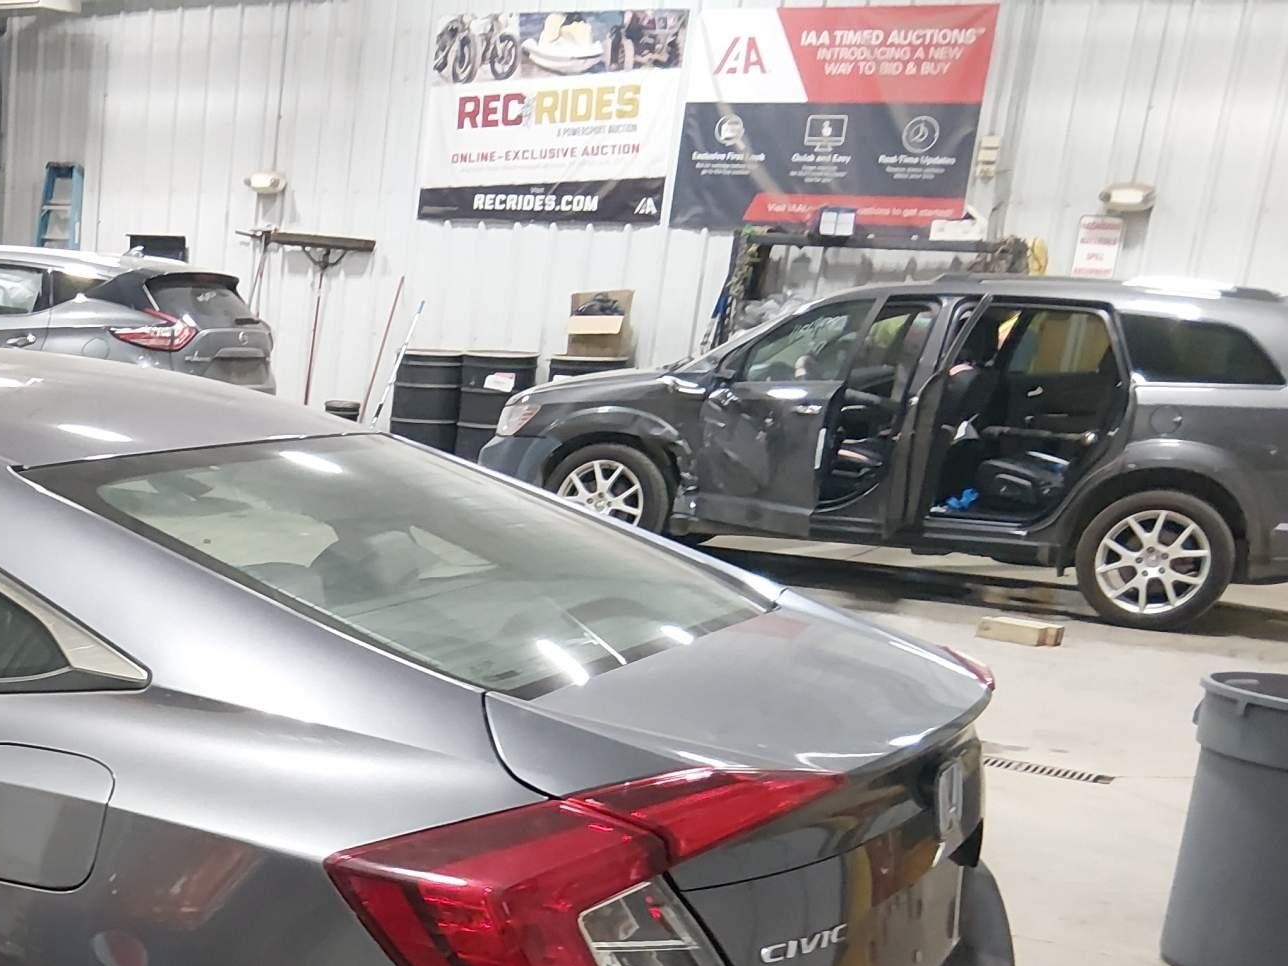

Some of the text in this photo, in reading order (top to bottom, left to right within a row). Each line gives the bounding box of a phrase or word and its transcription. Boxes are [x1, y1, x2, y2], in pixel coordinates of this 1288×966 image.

[800, 30, 830, 46] IAA
[833, 29, 884, 45] TIMED
[816, 46, 964, 61] INTRODUCING A NEW
[824, 62, 854, 76] WAY
[857, 61, 875, 75] TO
[879, 61, 903, 75] BID
[920, 61, 951, 75] BUY
[451, 143, 640, 165] ONLINE-EXCLUSIVE AUCTION
[473, 193, 599, 213] RECRIDES.COM
[760, 923, 847, 963] CIVIC
